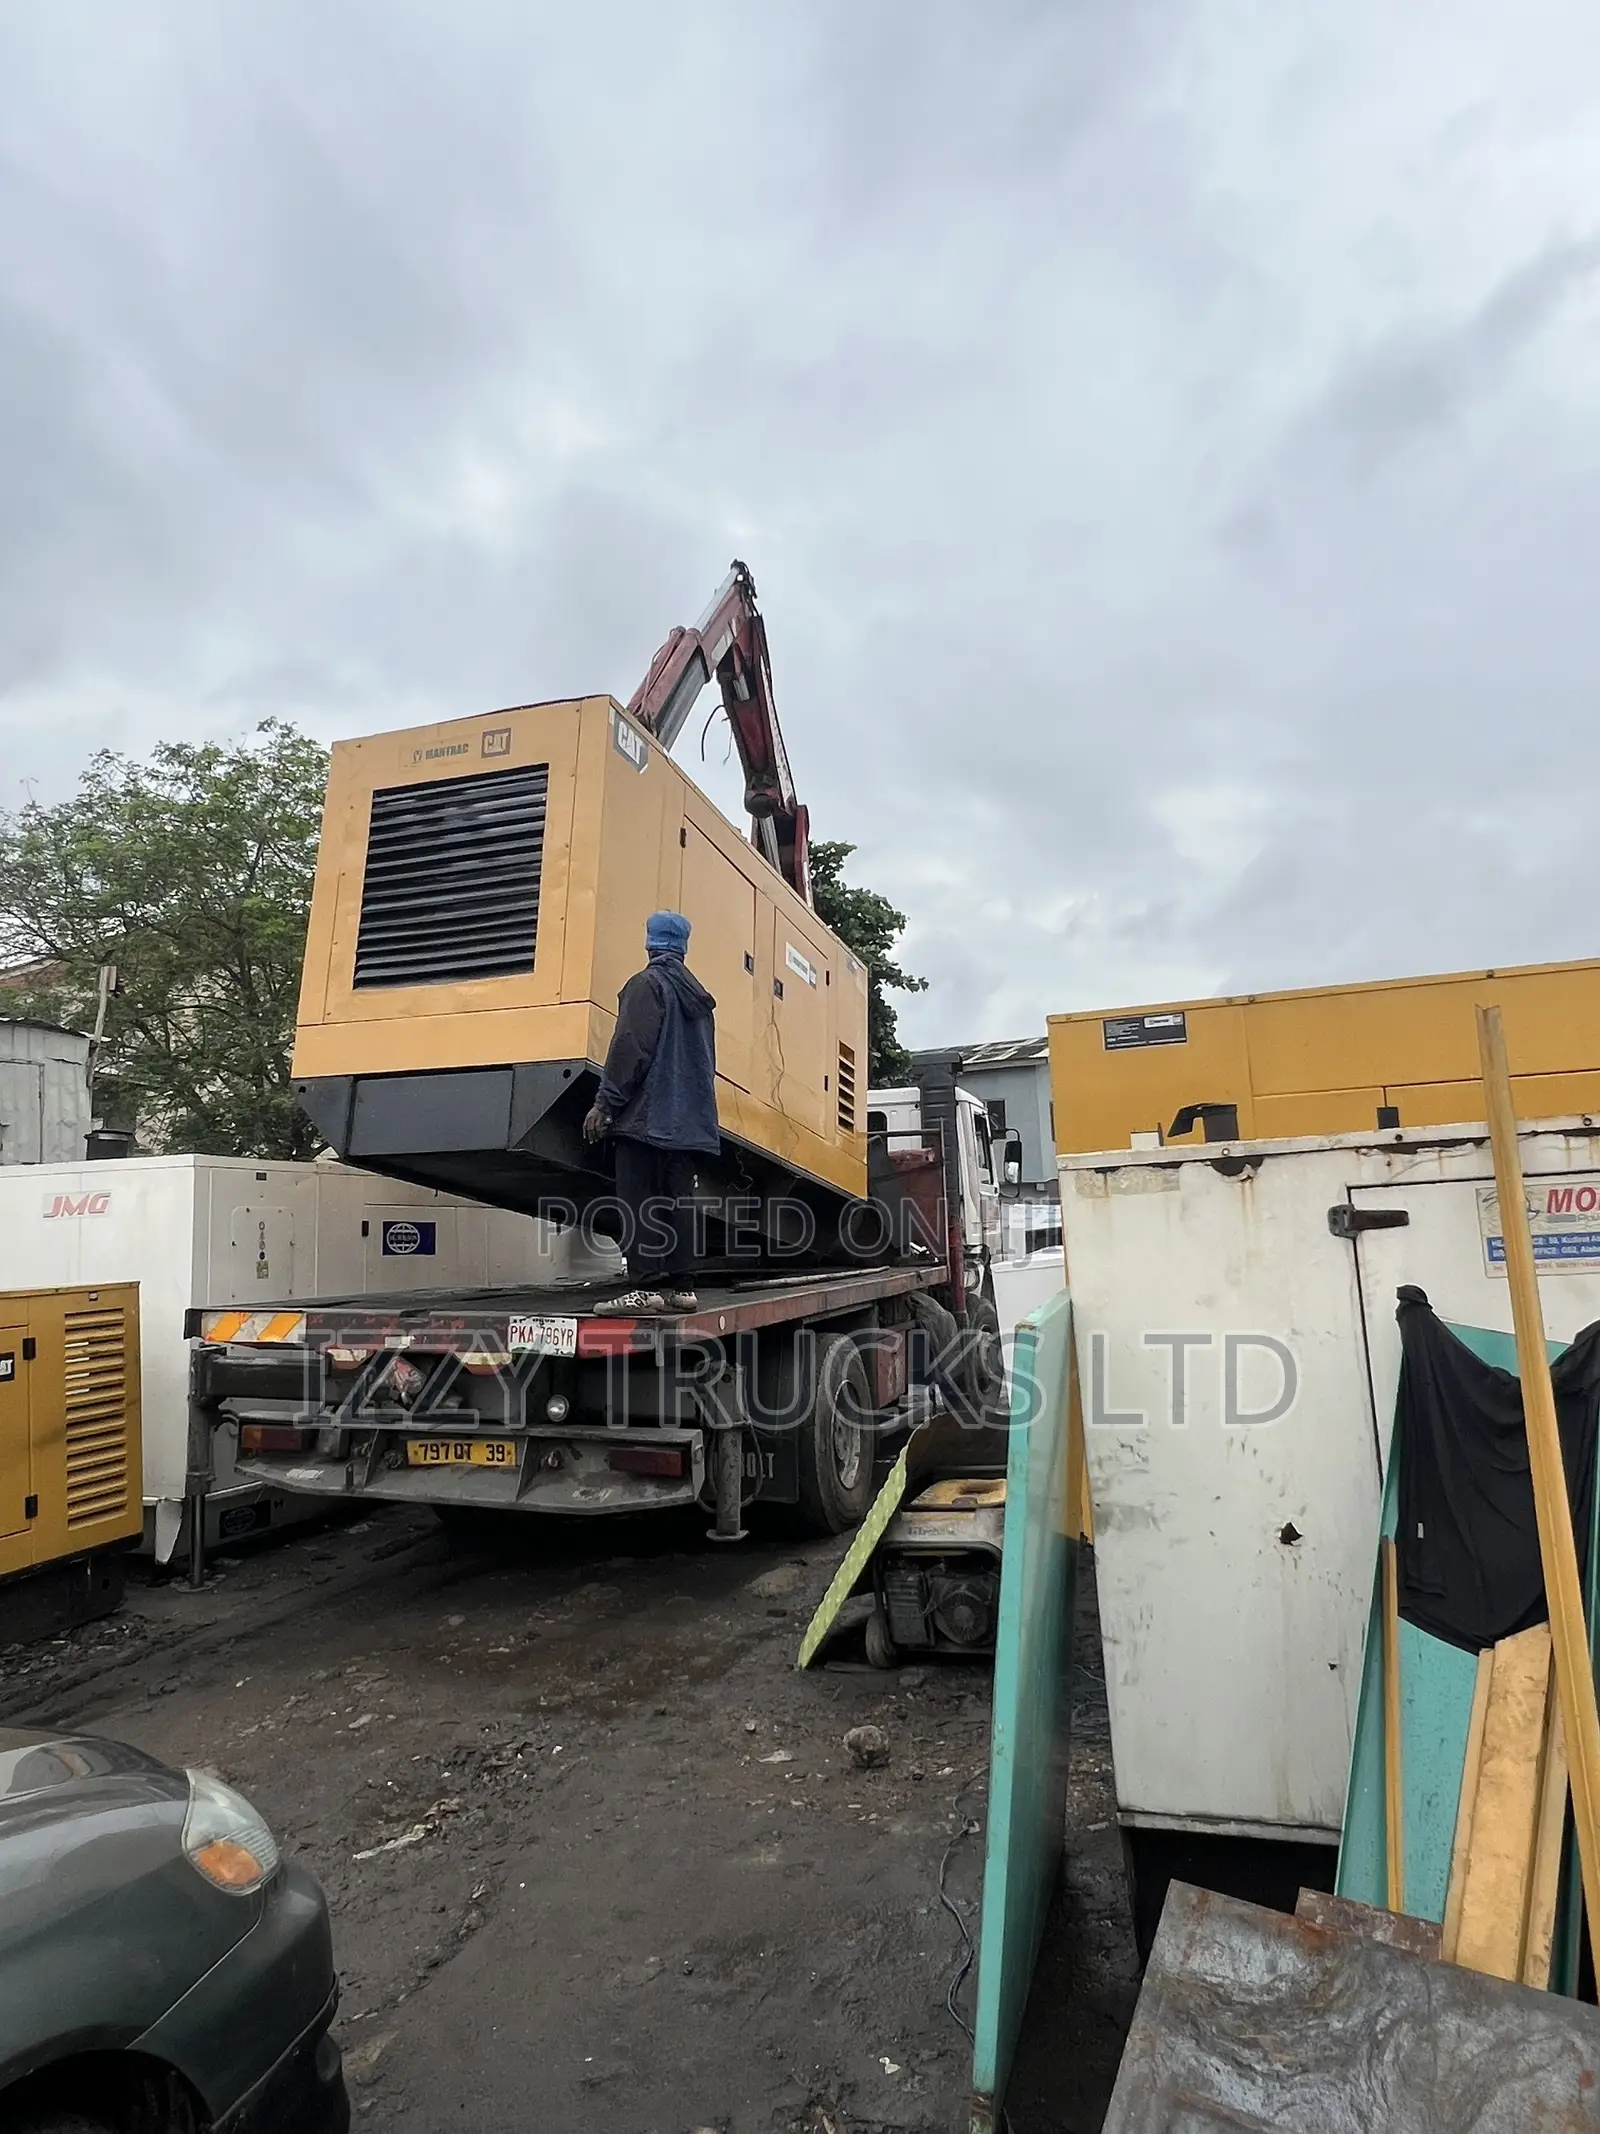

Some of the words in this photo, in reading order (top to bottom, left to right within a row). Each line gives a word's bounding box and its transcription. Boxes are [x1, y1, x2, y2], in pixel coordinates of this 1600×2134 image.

[425, 743, 469, 760] MANTRAC
[483, 732, 510, 754] CAT
[617, 721, 643, 765] CAT
[42, 1192, 111, 1218] JMG
[1546, 1186, 1600, 1214] MO
[485, 1443, 506, 1462] 39
